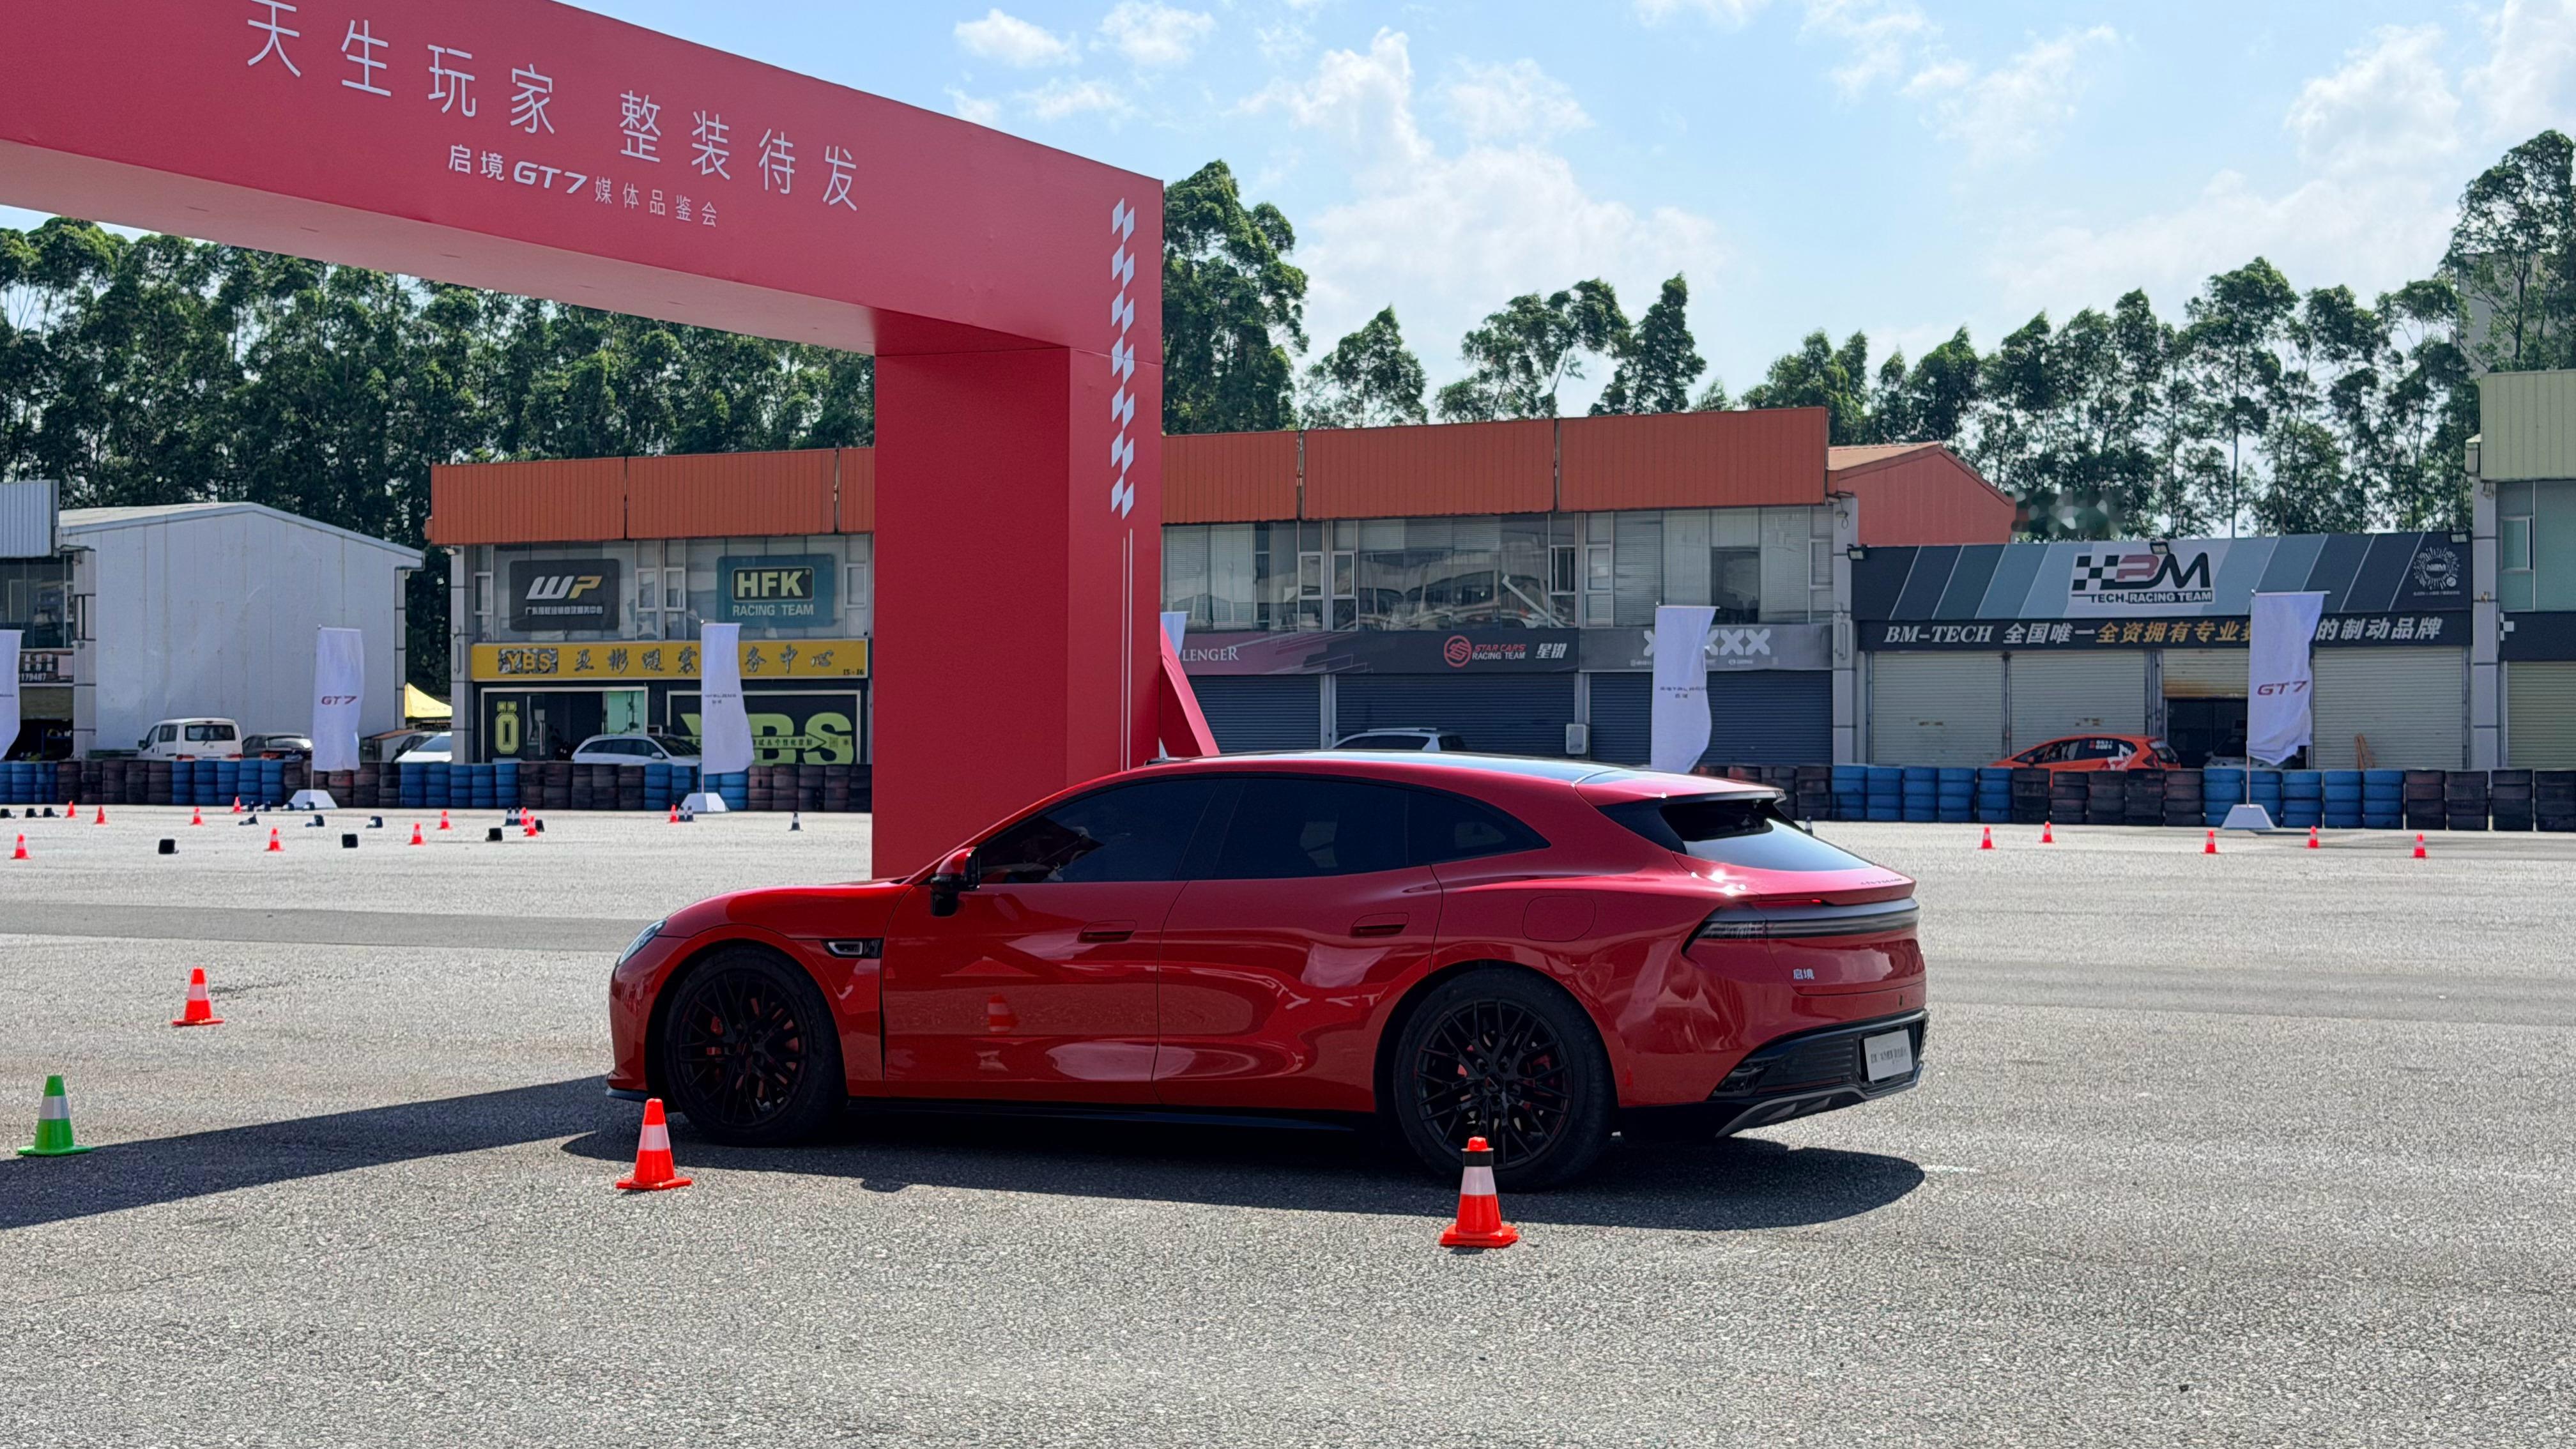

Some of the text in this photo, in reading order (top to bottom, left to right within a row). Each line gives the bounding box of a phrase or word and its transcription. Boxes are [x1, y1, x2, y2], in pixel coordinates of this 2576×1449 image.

[247, 0, 858, 211] 天生玩家 整装待发
[448, 144, 717, 227] 启境 GT7 媒体品鉴会
[737, 571, 803, 597] HFK
[2129, 591, 2175, 602] RACING
[2177, 590, 2212, 602] TEAM
[733, 604, 813, 616] RACING TEAM
[1884, 625, 1993, 643] BM-TECH
[1500, 643, 1526, 652] CARS
[1472, 651, 1526, 660] RACING TEAM
[2257, 680, 2308, 695] GT7
[321, 695, 357, 705] GT7
